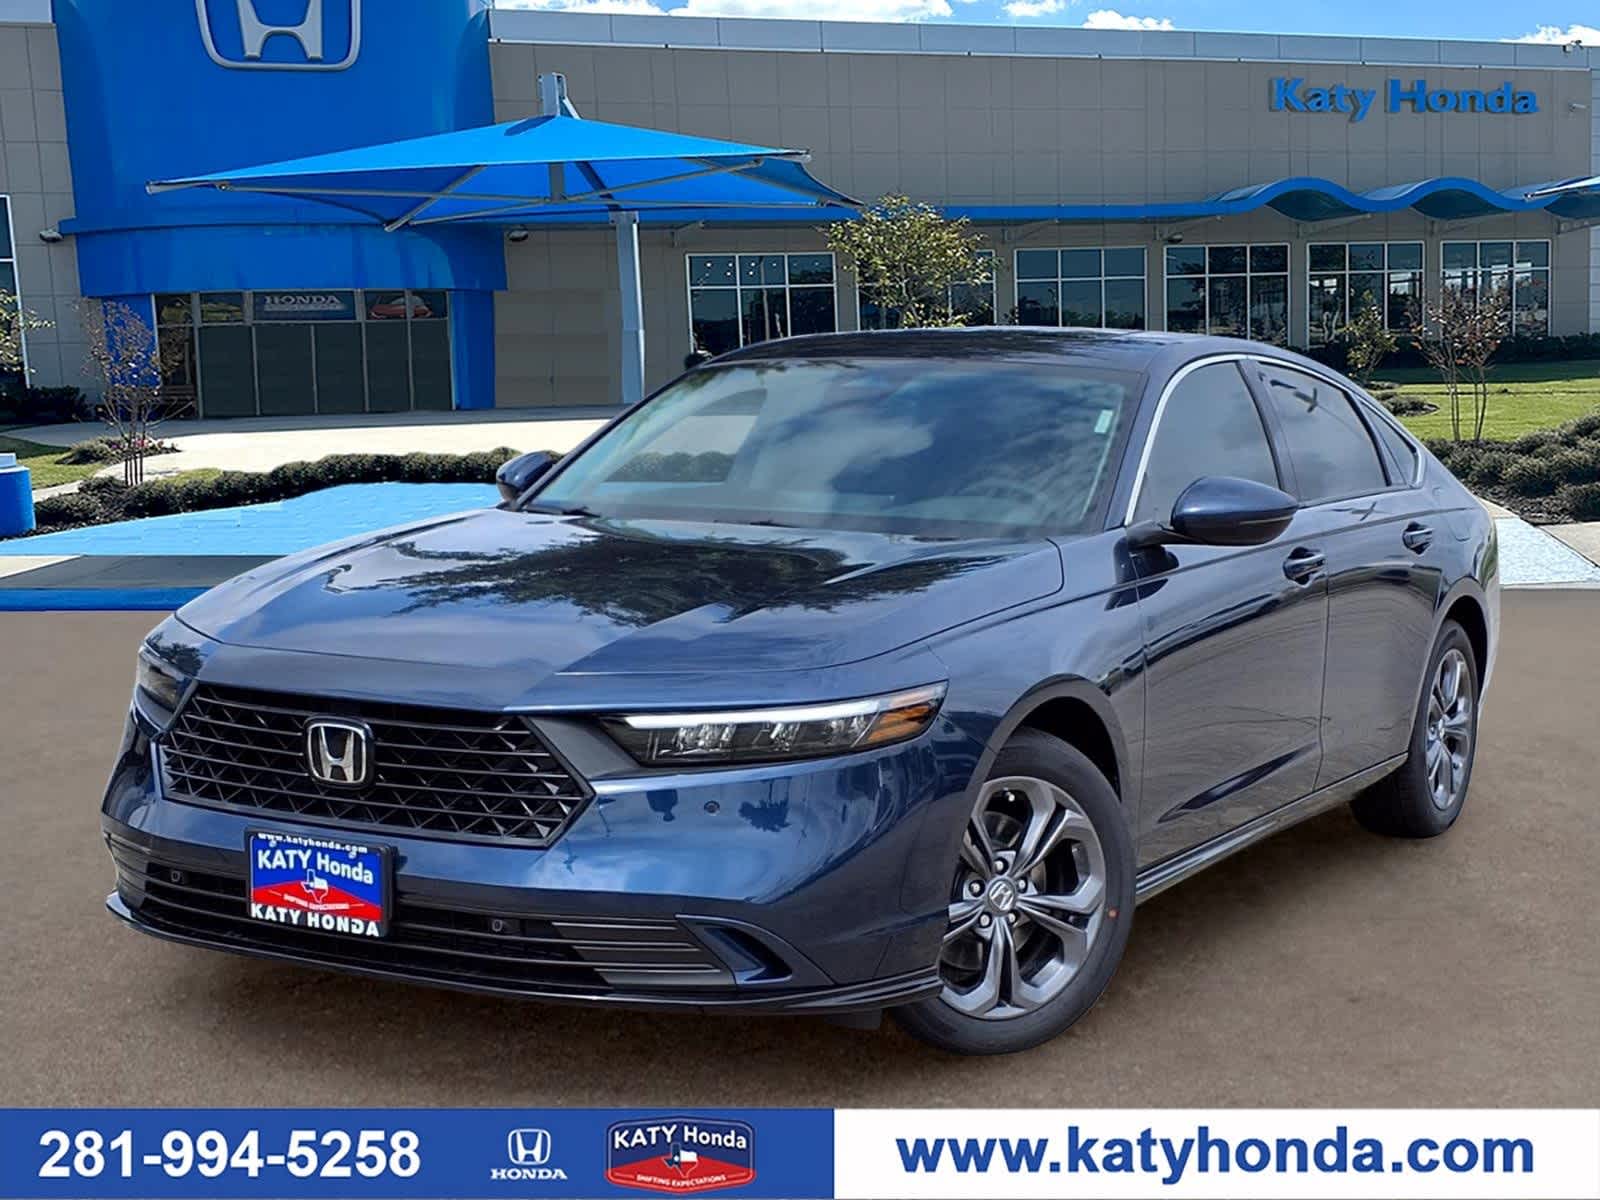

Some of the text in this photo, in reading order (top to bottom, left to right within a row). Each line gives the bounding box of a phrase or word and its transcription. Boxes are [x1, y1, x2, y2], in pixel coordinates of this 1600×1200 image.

[1269, 77, 1540, 122] Katy Honda
[265, 295, 341, 304] HONDA
[258, 833, 367, 854] www.katyhonda.com
[258, 849, 374, 885] KATY Honda
[251, 903, 380, 937] KATY HONDA
